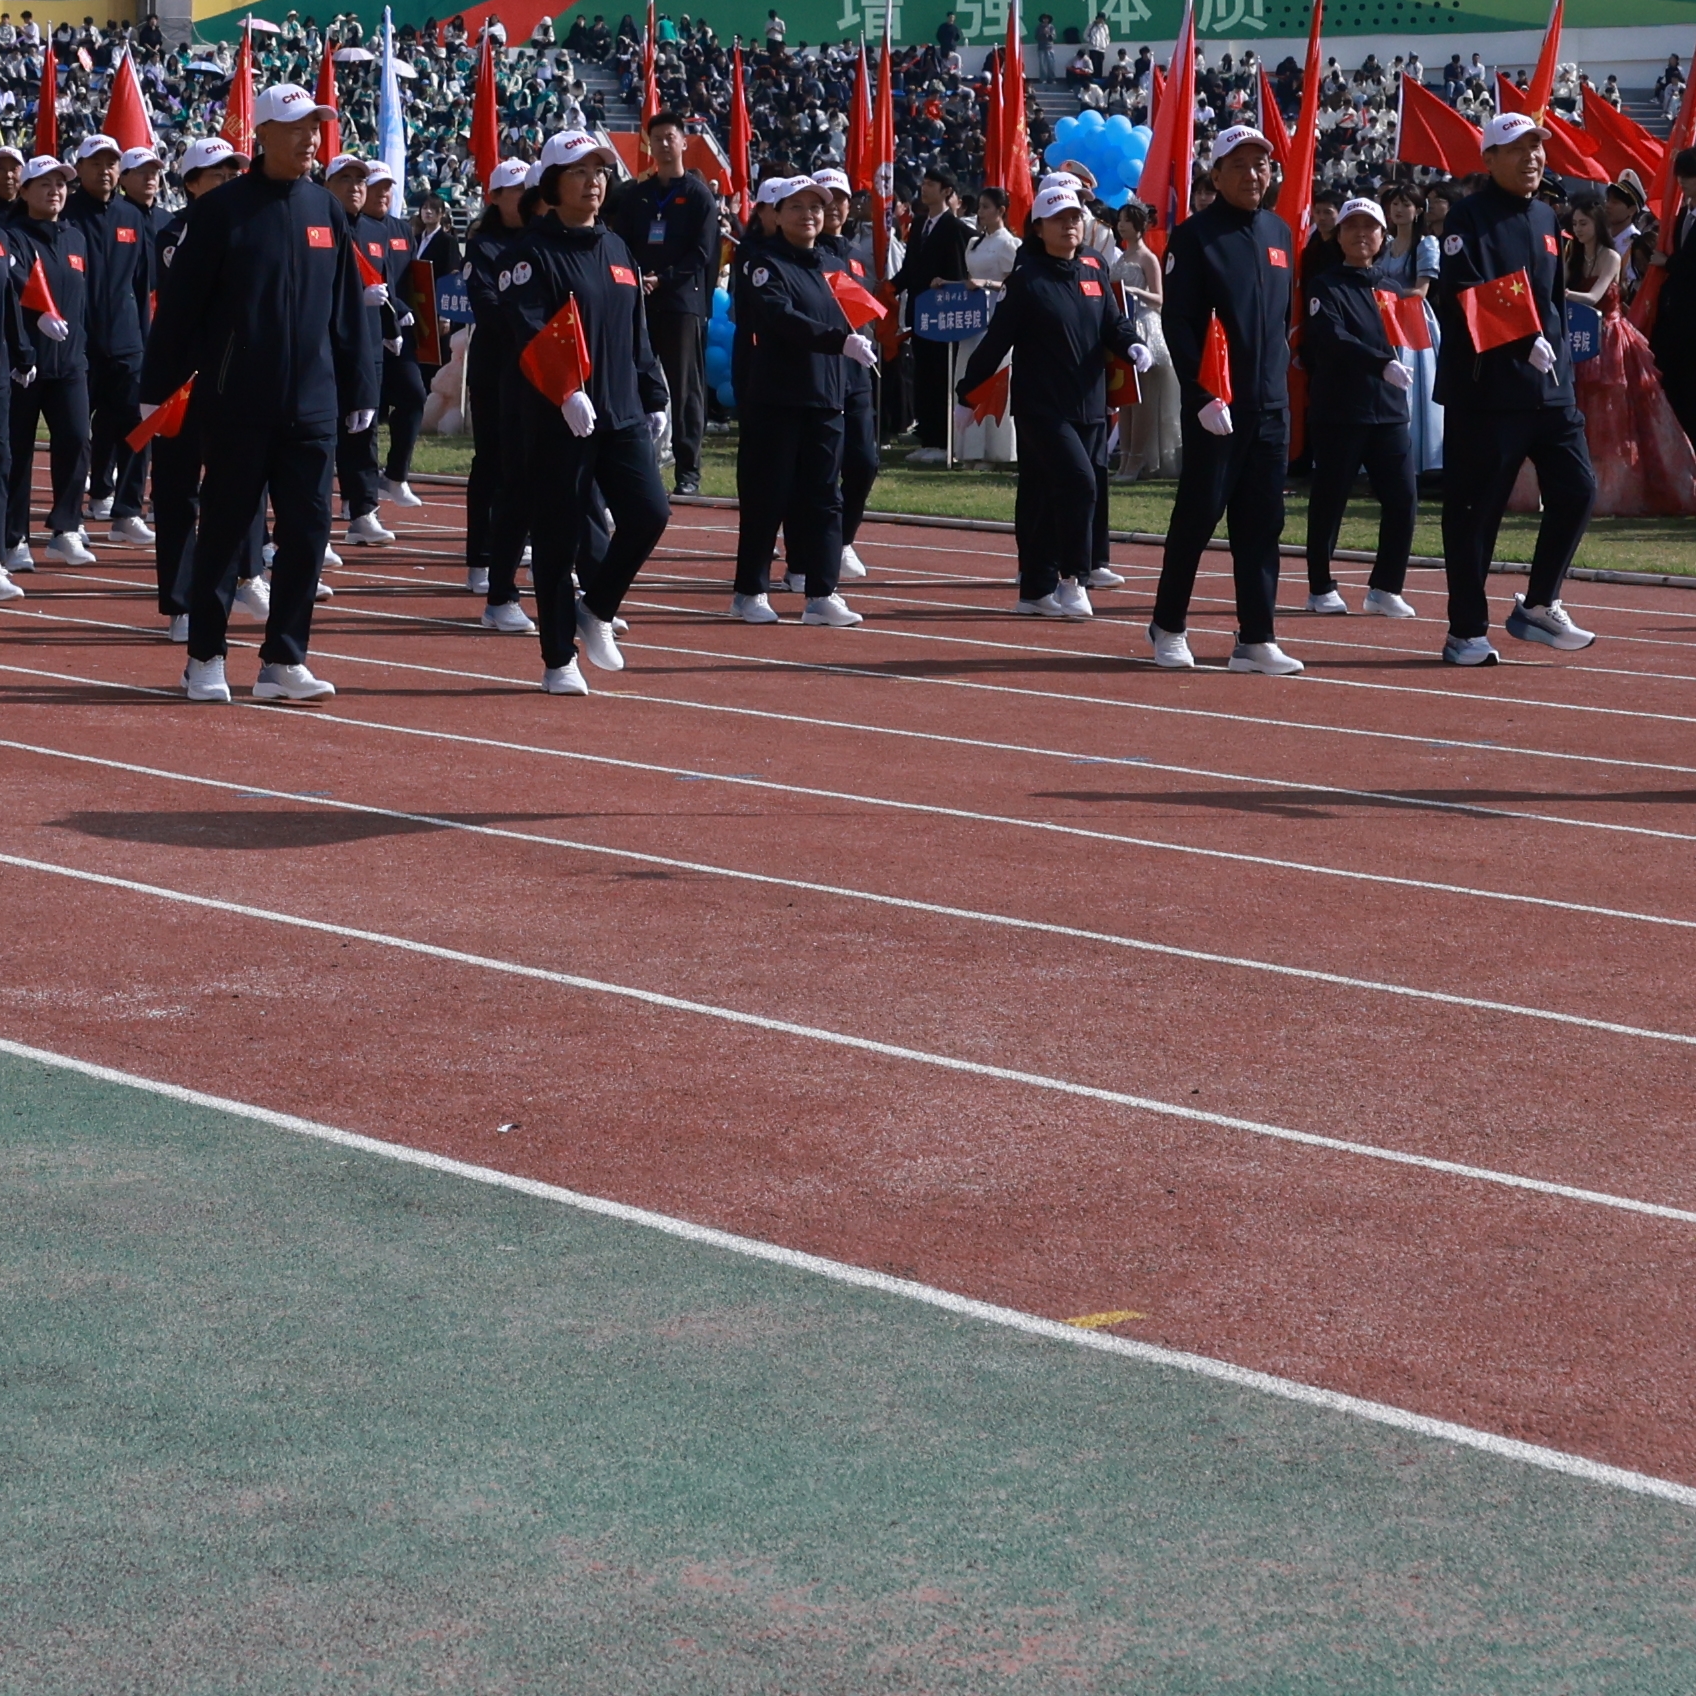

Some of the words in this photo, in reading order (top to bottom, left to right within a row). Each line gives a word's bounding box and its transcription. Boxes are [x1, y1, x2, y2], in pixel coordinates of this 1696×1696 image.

[1502, 118, 1533, 131] CHINA
[816, 175, 845, 186] CHINA
[1047, 193, 1076, 206] CHINA
[1346, 201, 1376, 213] CHINA
[440, 293, 474, 313] 信息管
[920, 310, 982, 331] 第一临床医学院
[1568, 331, 1591, 353] 学院
